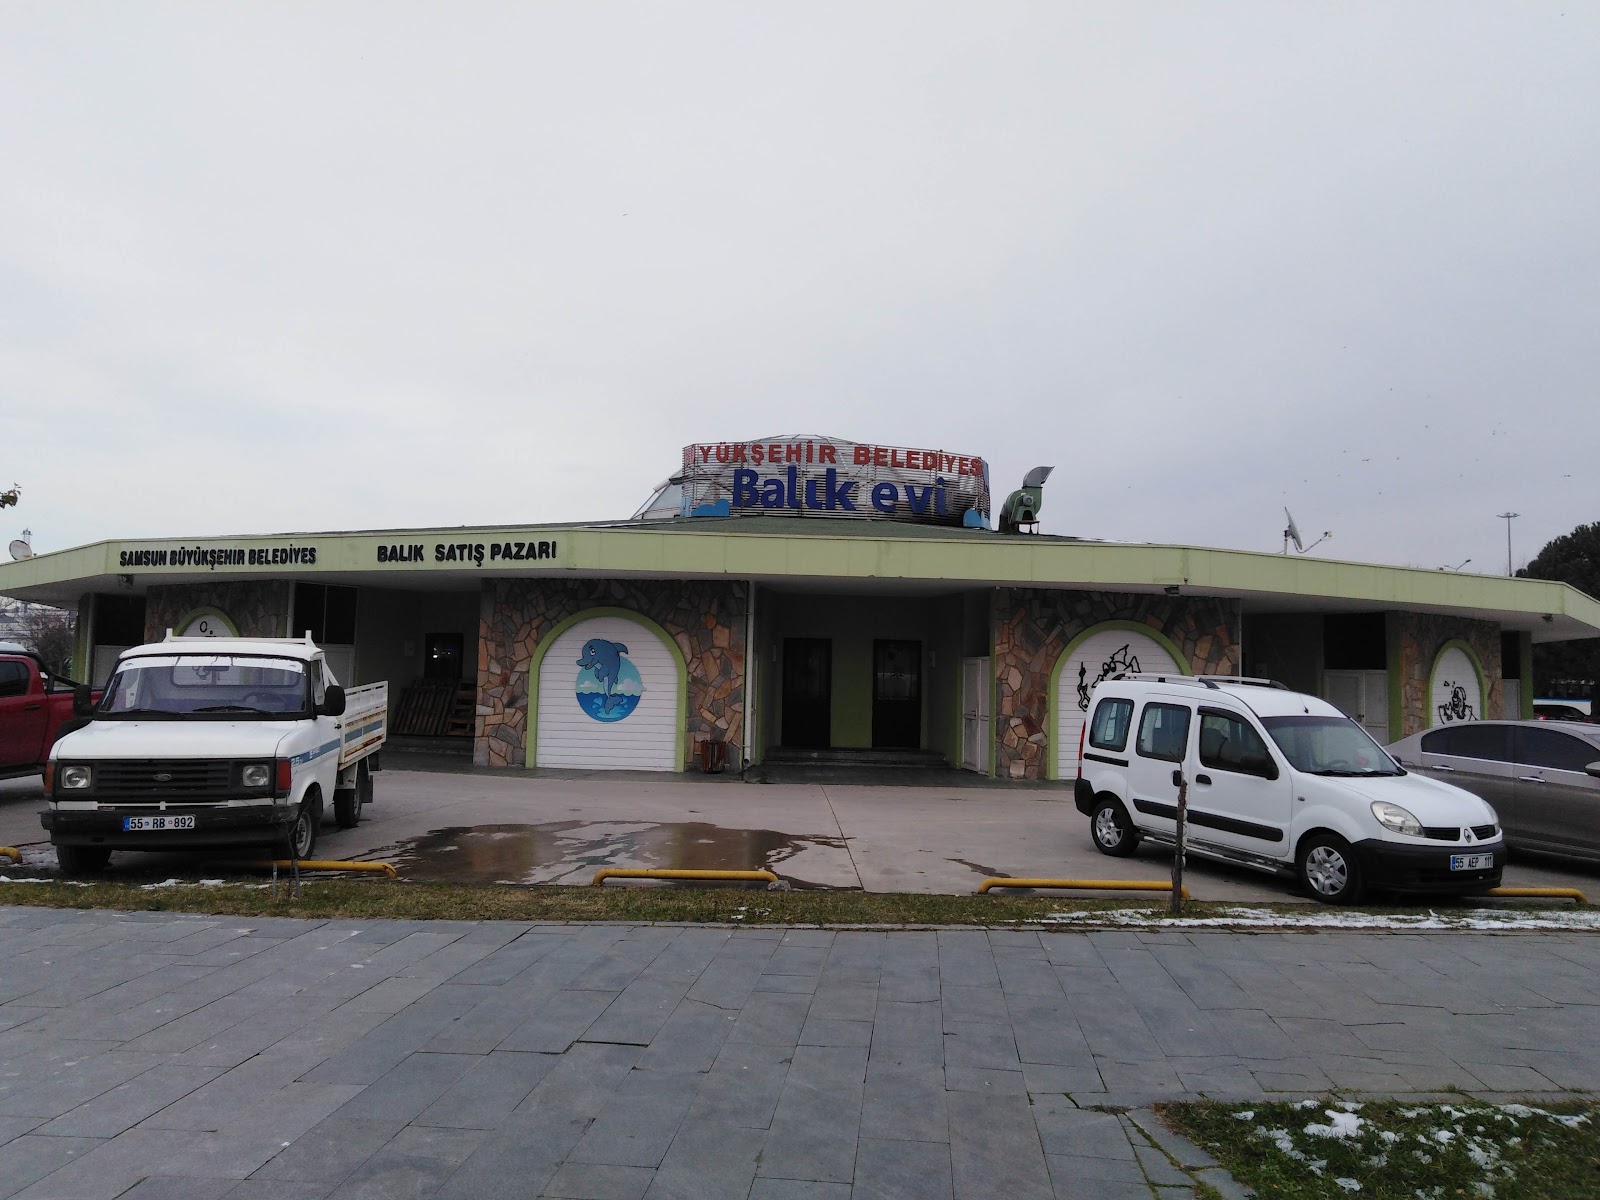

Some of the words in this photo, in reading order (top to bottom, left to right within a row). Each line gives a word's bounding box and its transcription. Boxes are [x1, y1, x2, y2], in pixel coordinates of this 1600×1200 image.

[871, 476, 949, 517] evi
[119, 550, 167, 566] SAMSUN
[248, 543, 317, 565] BELEDİYES
[377, 544, 424, 562] BALIK
[435, 543, 485, 567] SATIŞ
[490, 540, 557, 561] PAZARI
[130, 818, 143, 829] 55
[152, 818, 166, 829] RB
[173, 817, 193, 828] 892
[1455, 857, 1464, 868] 55
